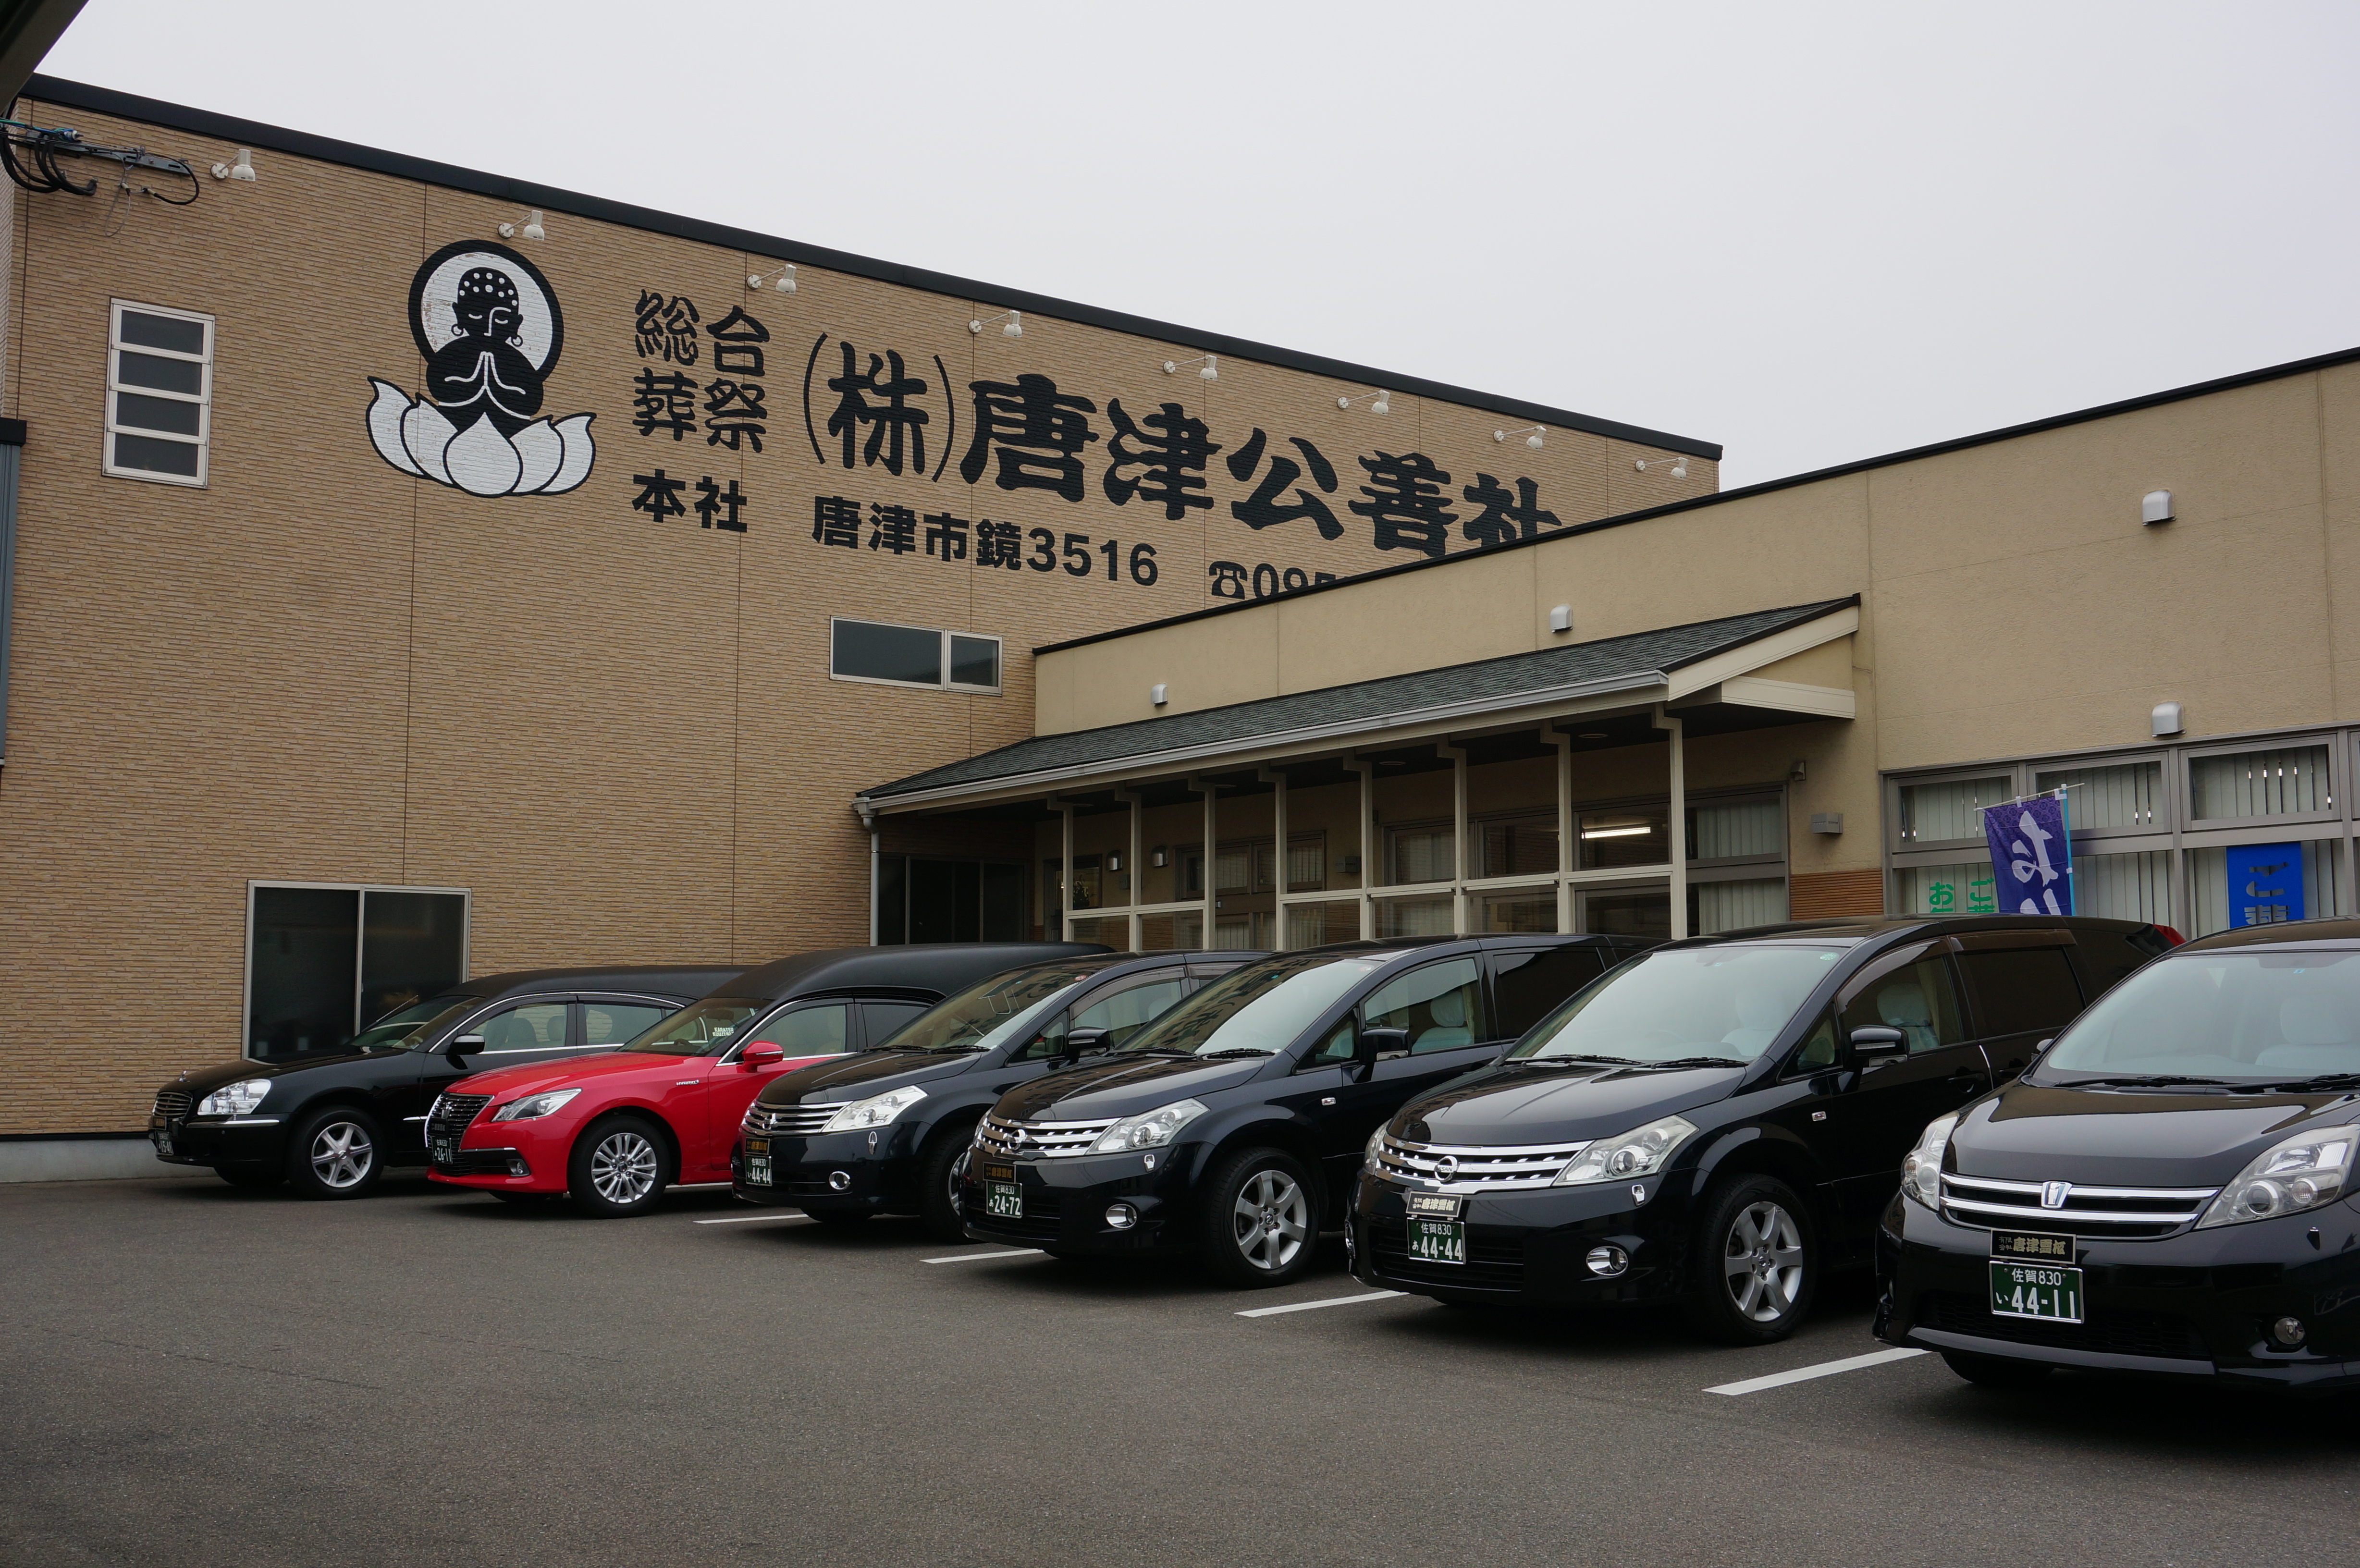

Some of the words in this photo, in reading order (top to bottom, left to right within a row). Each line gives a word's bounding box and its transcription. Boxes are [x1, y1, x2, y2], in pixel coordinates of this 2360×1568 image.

[632, 289, 770, 377] 総合
[633, 367, 767, 453] 葬祭
[632, 469, 747, 533] 本社
[811, 495, 1158, 586] 唐津市鏡3516
